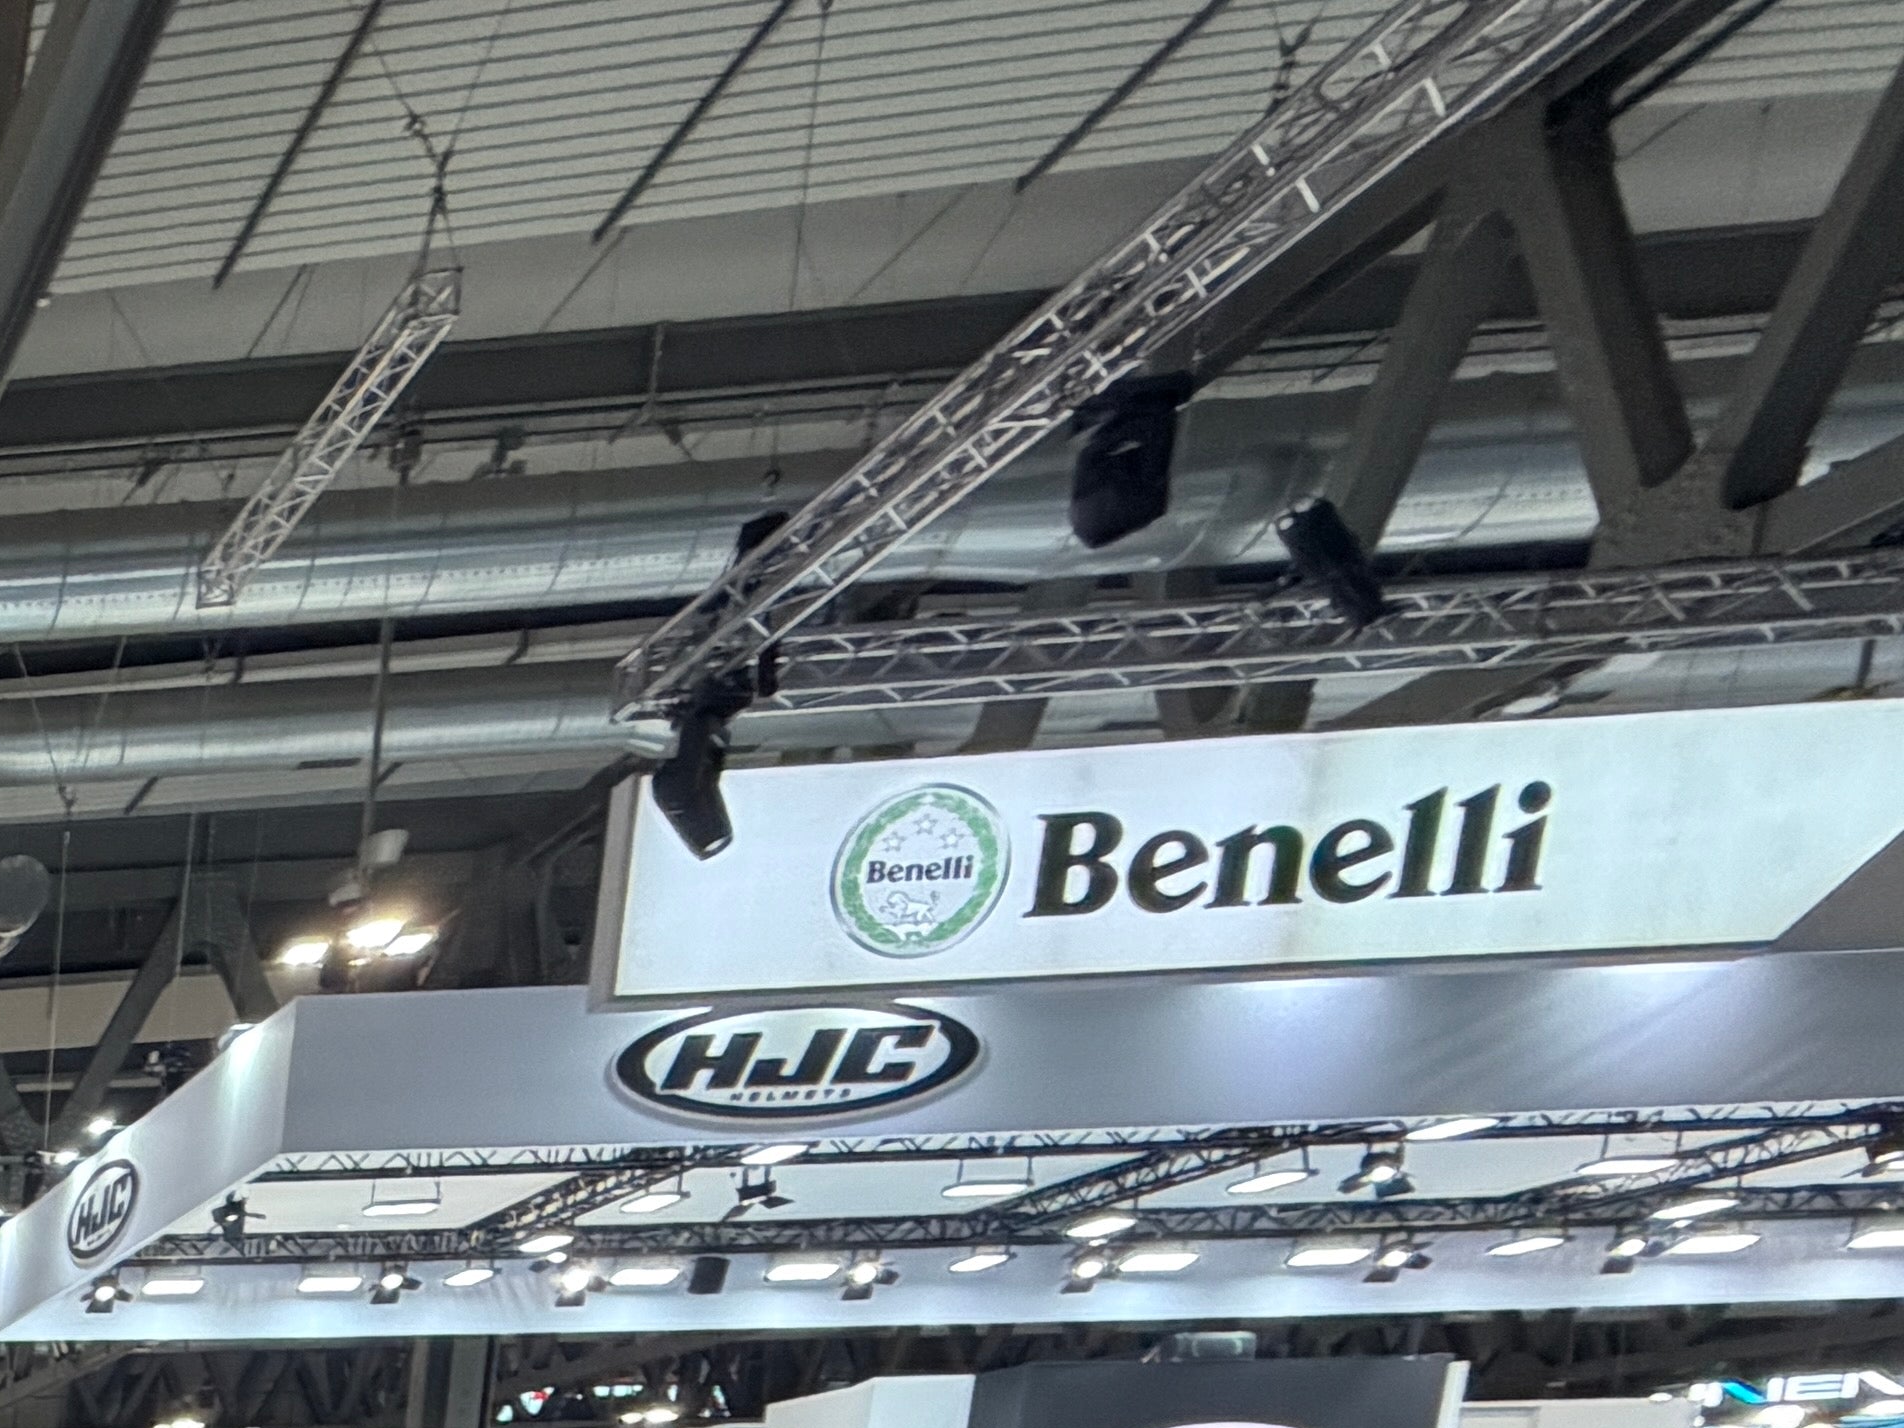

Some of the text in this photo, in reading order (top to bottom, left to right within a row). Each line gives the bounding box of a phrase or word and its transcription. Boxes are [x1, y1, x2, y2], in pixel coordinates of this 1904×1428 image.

[866, 855, 975, 884] Benelli
[1023, 780, 1553, 919] Benelli
[660, 1025, 937, 1094] HJC
[73, 1175, 132, 1244] HJC
